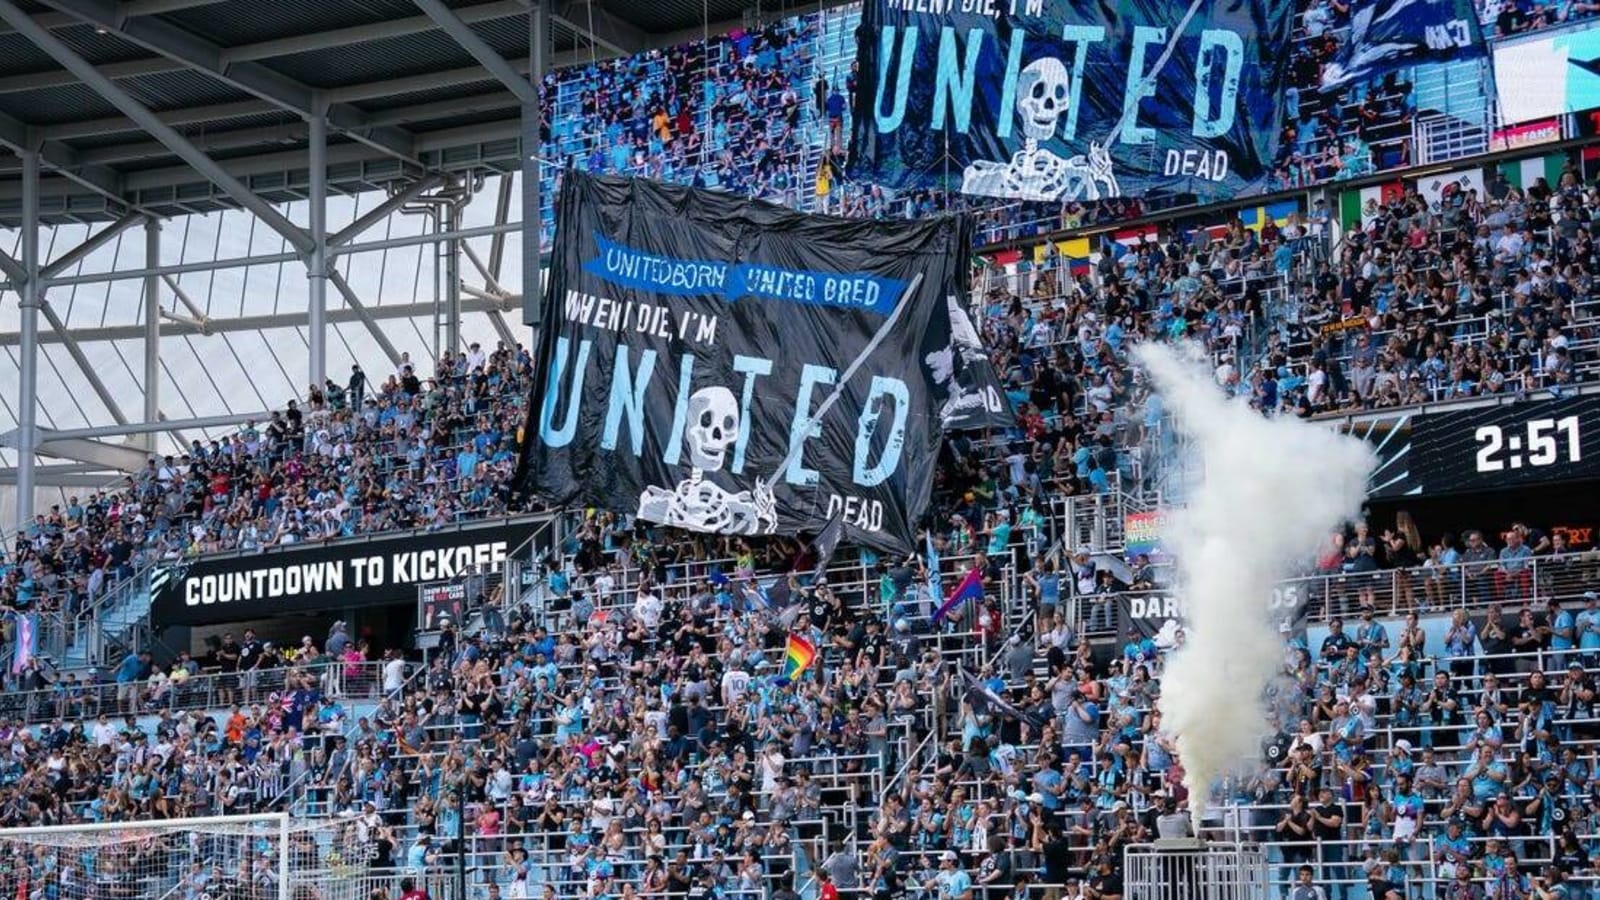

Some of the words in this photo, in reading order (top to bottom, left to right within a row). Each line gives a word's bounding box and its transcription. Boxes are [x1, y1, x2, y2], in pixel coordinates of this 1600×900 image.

[887, 0, 942, 15] EN
[873, 25, 1244, 145] UNITED
[1164, 148, 1228, 182] DEAD
[605, 247, 671, 283] UNITED
[747, 267, 816, 301] UNITED
[823, 278, 881, 306] BRED
[564, 289, 622, 332] WHEN
[635, 303, 673, 343] DIE,
[678, 311, 718, 346] I'M
[538, 335, 910, 488] UNITED
[1474, 415, 1581, 473] 2:51
[826, 493, 884, 532] DEAD
[185, 559, 344, 606] COUNTDOWN
[351, 555, 385, 588] TO
[392, 541, 508, 584] KICKOFF
[1130, 597, 1188, 619] DAR
[732, 679, 745, 691] 10
